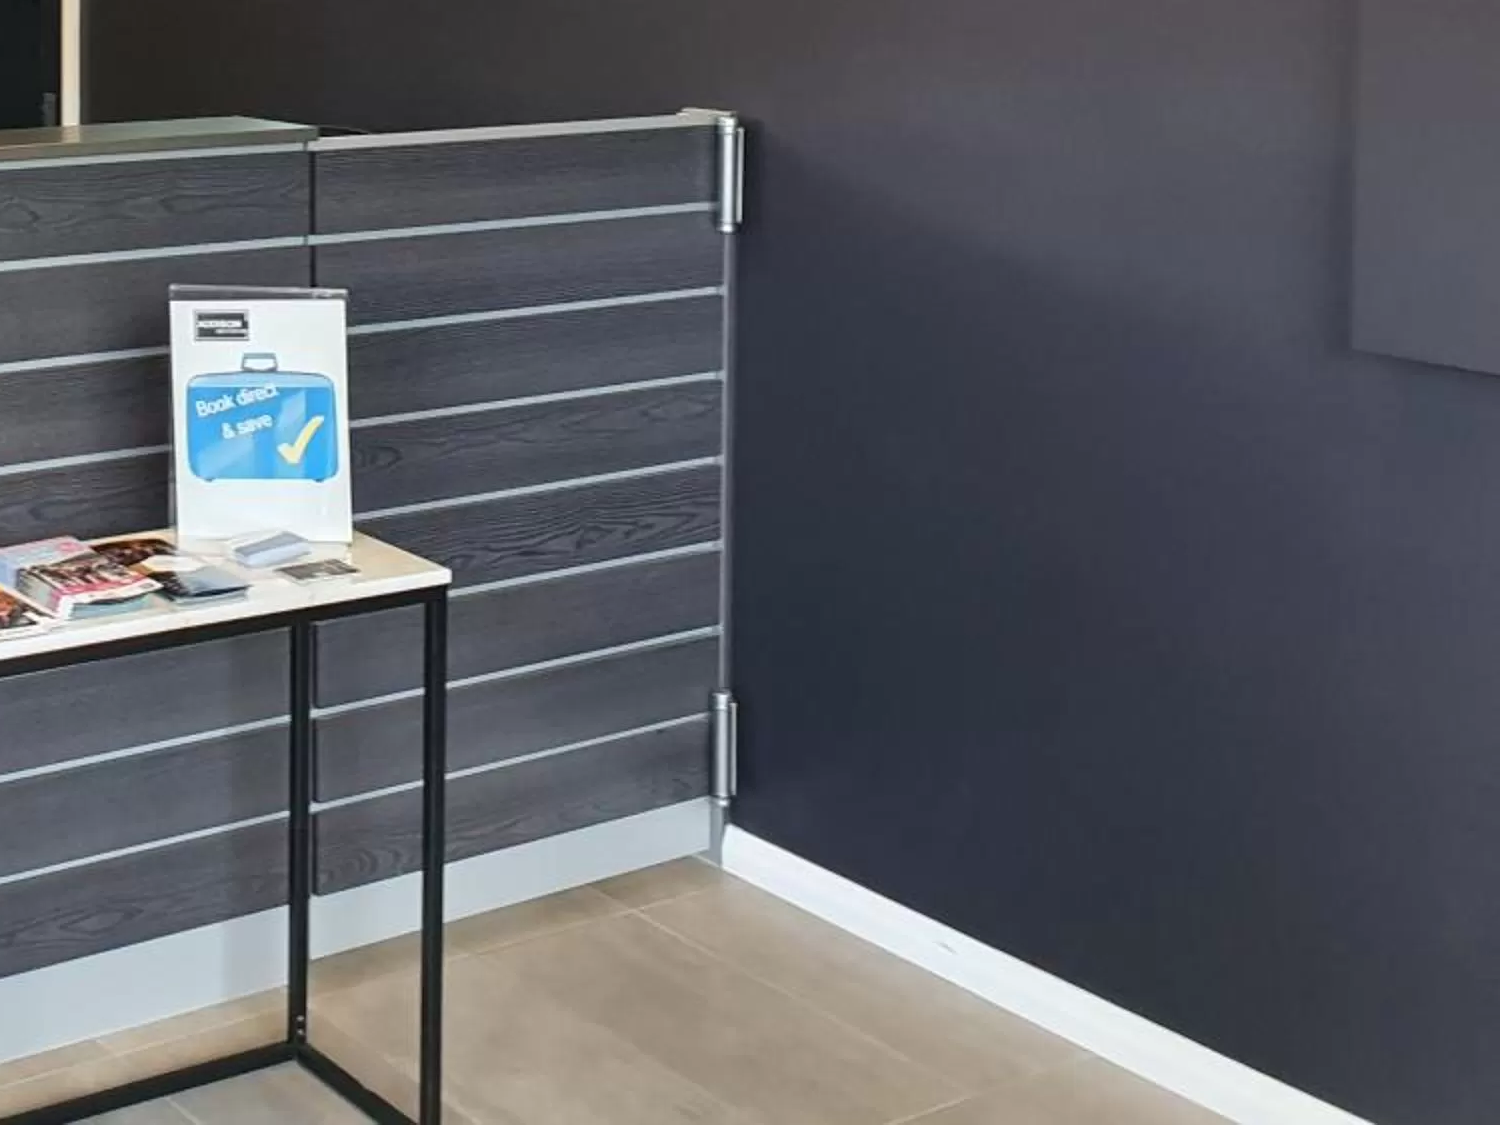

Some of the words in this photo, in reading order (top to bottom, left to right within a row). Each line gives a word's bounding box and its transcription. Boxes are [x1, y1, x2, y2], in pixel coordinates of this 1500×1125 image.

[195, 394, 237, 417] Book
[236, 383, 279, 406] direct
[221, 422, 236, 439] &
[236, 415, 273, 435] save
